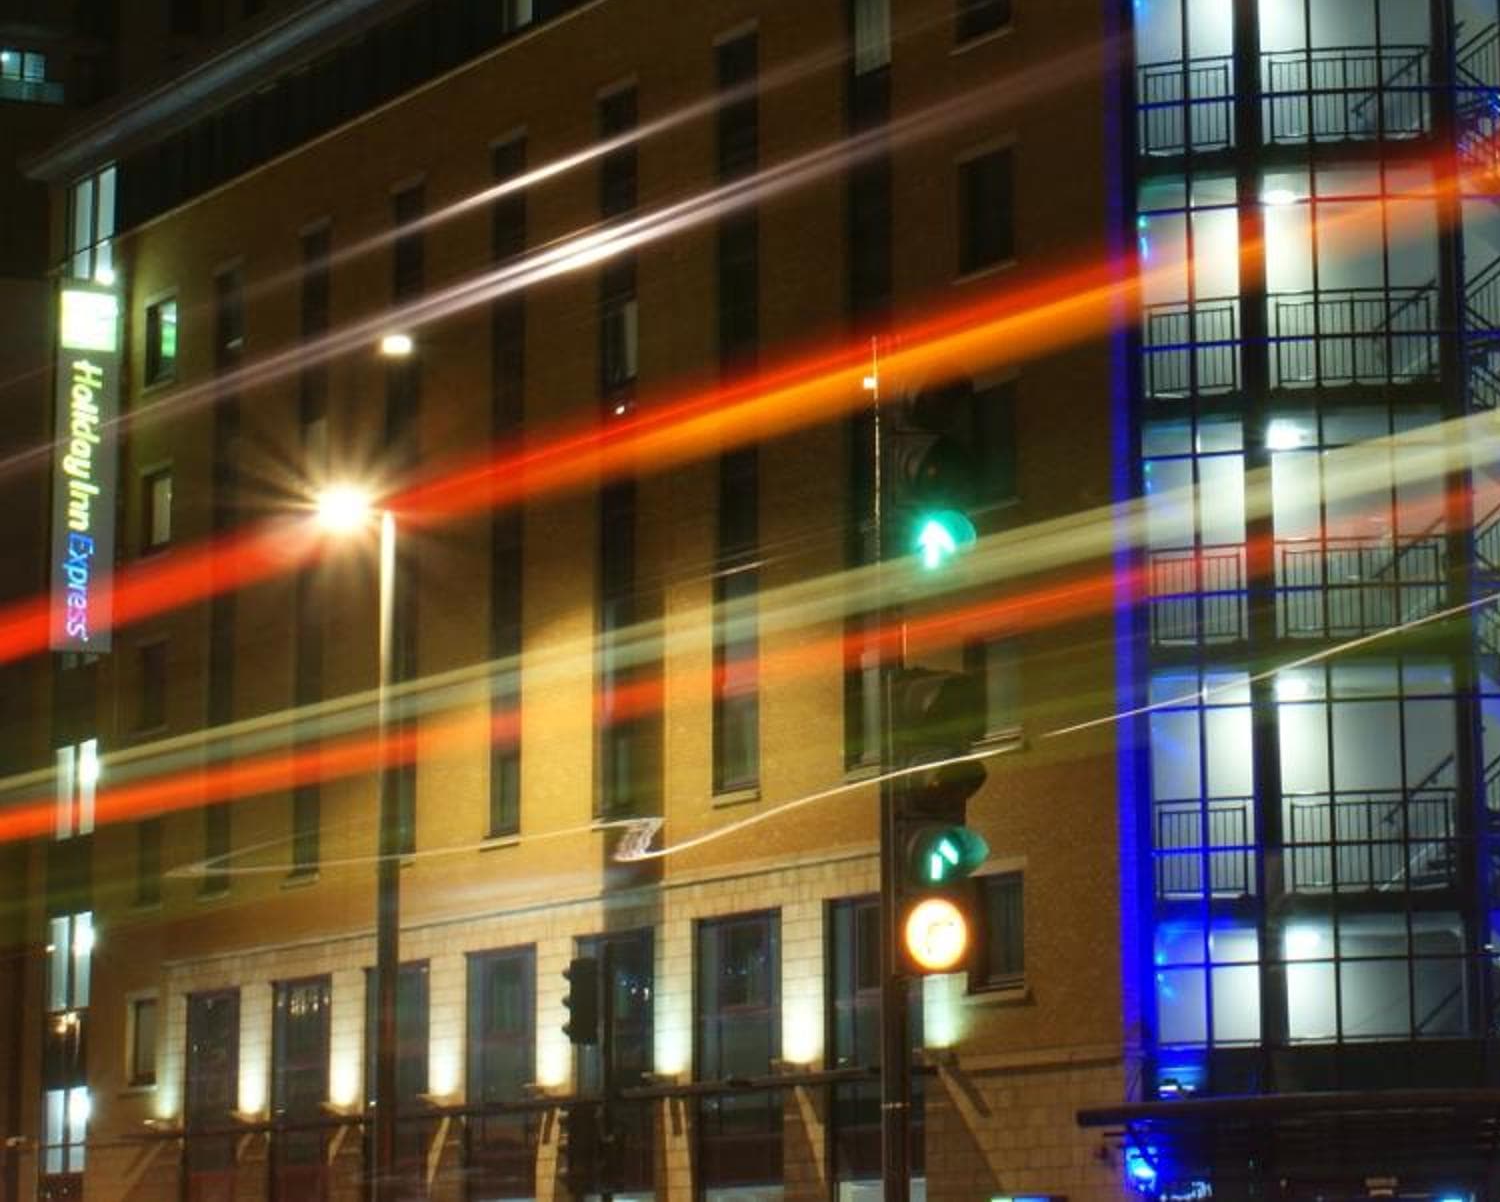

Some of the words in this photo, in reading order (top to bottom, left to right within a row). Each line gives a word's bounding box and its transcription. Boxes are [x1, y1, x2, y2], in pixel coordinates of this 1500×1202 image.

[63, 359, 103, 479] Holiday
[68, 480, 100, 531] Inn
[63, 532, 94, 637] Express
